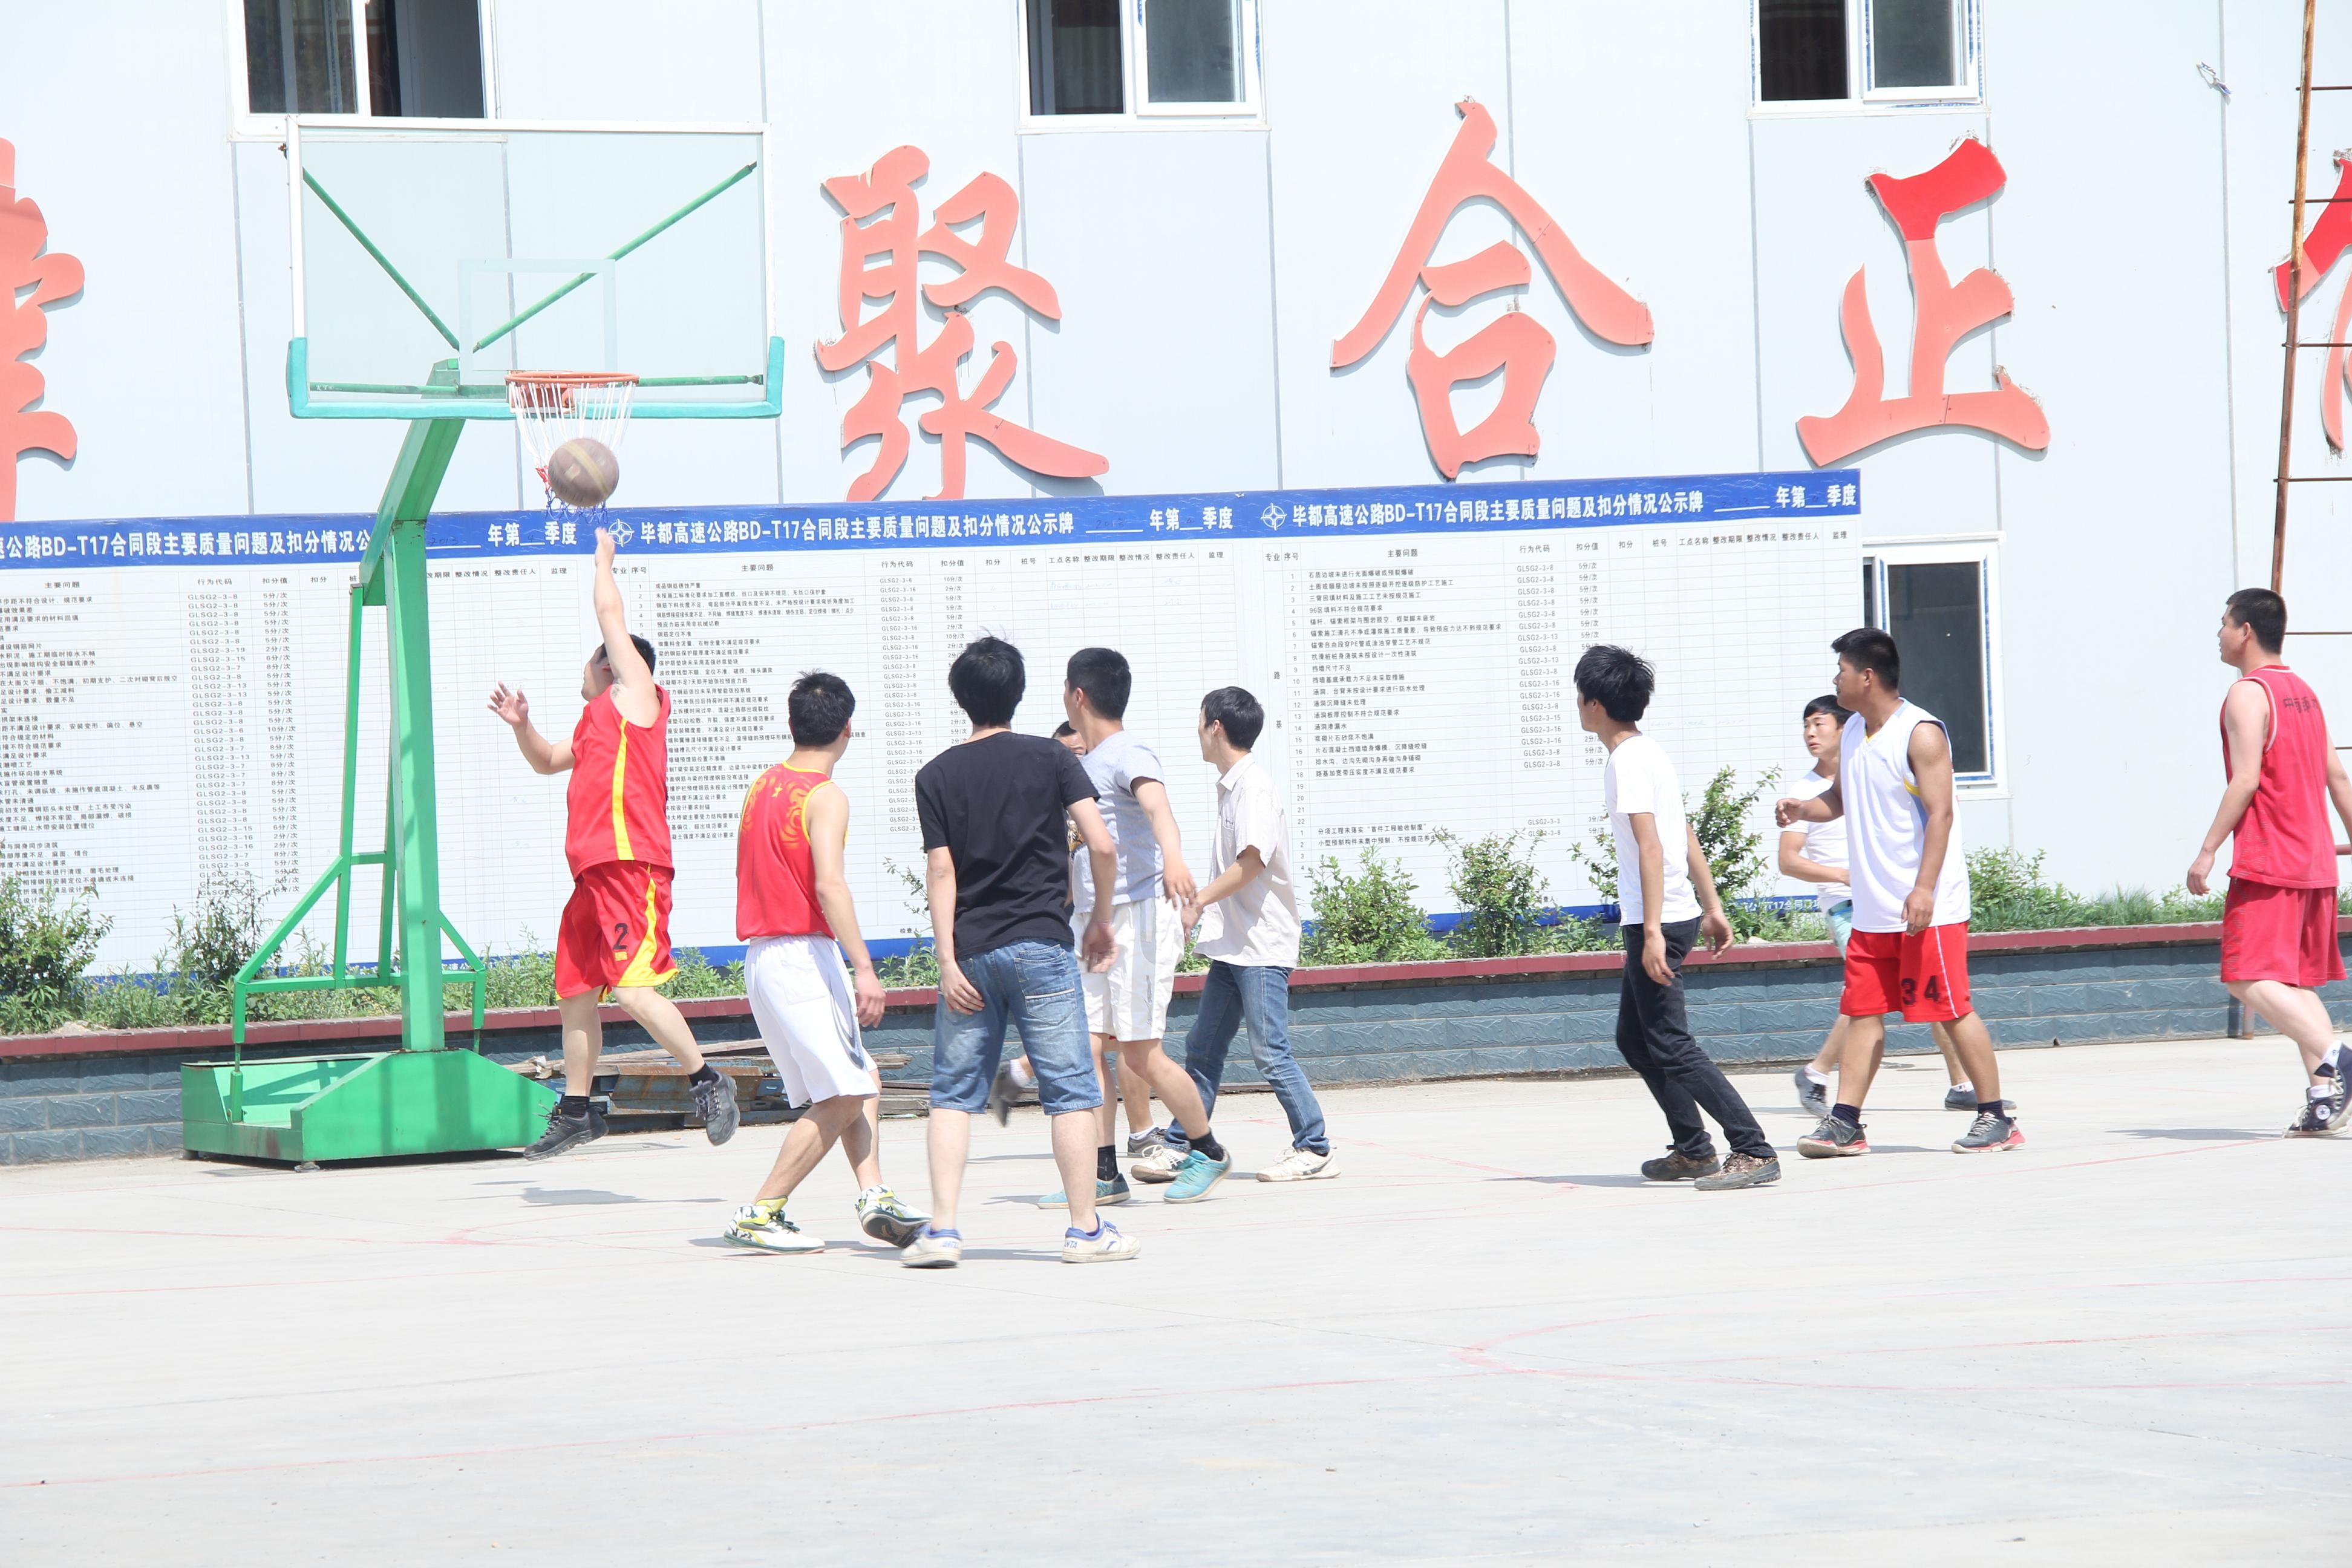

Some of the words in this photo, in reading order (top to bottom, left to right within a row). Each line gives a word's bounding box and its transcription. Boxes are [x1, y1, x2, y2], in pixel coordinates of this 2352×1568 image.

[1292, 490, 1704, 528] 毕都高速公路BD-T17合同段主要质量问题及扣分情况公示牌
[1775, 485, 1806, 509] 年第
[1827, 483, 1857, 508] 季度
[640, 511, 1074, 545] 毕都高速公路BD-T17合同段主要质量问题及扣分情况公示牌
[1149, 508, 1180, 532] 年第
[1203, 506, 1233, 531] 季度
[488, 522, 520, 547] 年第
[545, 520, 577, 545] 季度
[1264, 552, 1281, 562] 专业
[1284, 552, 1299, 561] 序号
[1387, 548, 1418, 558] 主要问题
[1519, 544, 1550, 554] 行为代码
[1576, 542, 1599, 552] 扣分值
[1618, 540, 1633, 549] 扣分
[1652, 538, 1667, 547] 桩号
[1679, 537, 1710, 546] 工点名称
[1712, 534, 1743, 545] 整改期限
[1746, 533, 1777, 543] 整改情况
[1782, 532, 1820, 541] 整改责任人
[1832, 531, 1847, 540] 监理
[631, 566, 647, 575] 序号
[741, 563, 774, 572] 主要问题
[881, 560, 913, 569] 行为代码
[940, 559, 964, 567] 扣分值
[1083, 554, 1115, 563] 整改期限
[1155, 552, 1195, 561] 整改责任人
[44, 581, 80, 589] 主要问题
[262, 577, 288, 585] 扣分值
[454, 570, 489, 578] 整改情况
[494, 567, 536, 577] 整改责任人
[1309, 604, 1383, 614] 96区填料不符合规范要求
[1312, 664, 1351, 673] 挡墙尺寸不足
[1312, 673, 1405, 684] 挡墙基底承载力不足未采取措施
[1313, 698, 1366, 707] 涵洞沉降缝未处理
[1314, 722, 1347, 731] 涵洞渗漏水
[614, 922, 630, 951] 2
[1901, 975, 1941, 1006] 34
